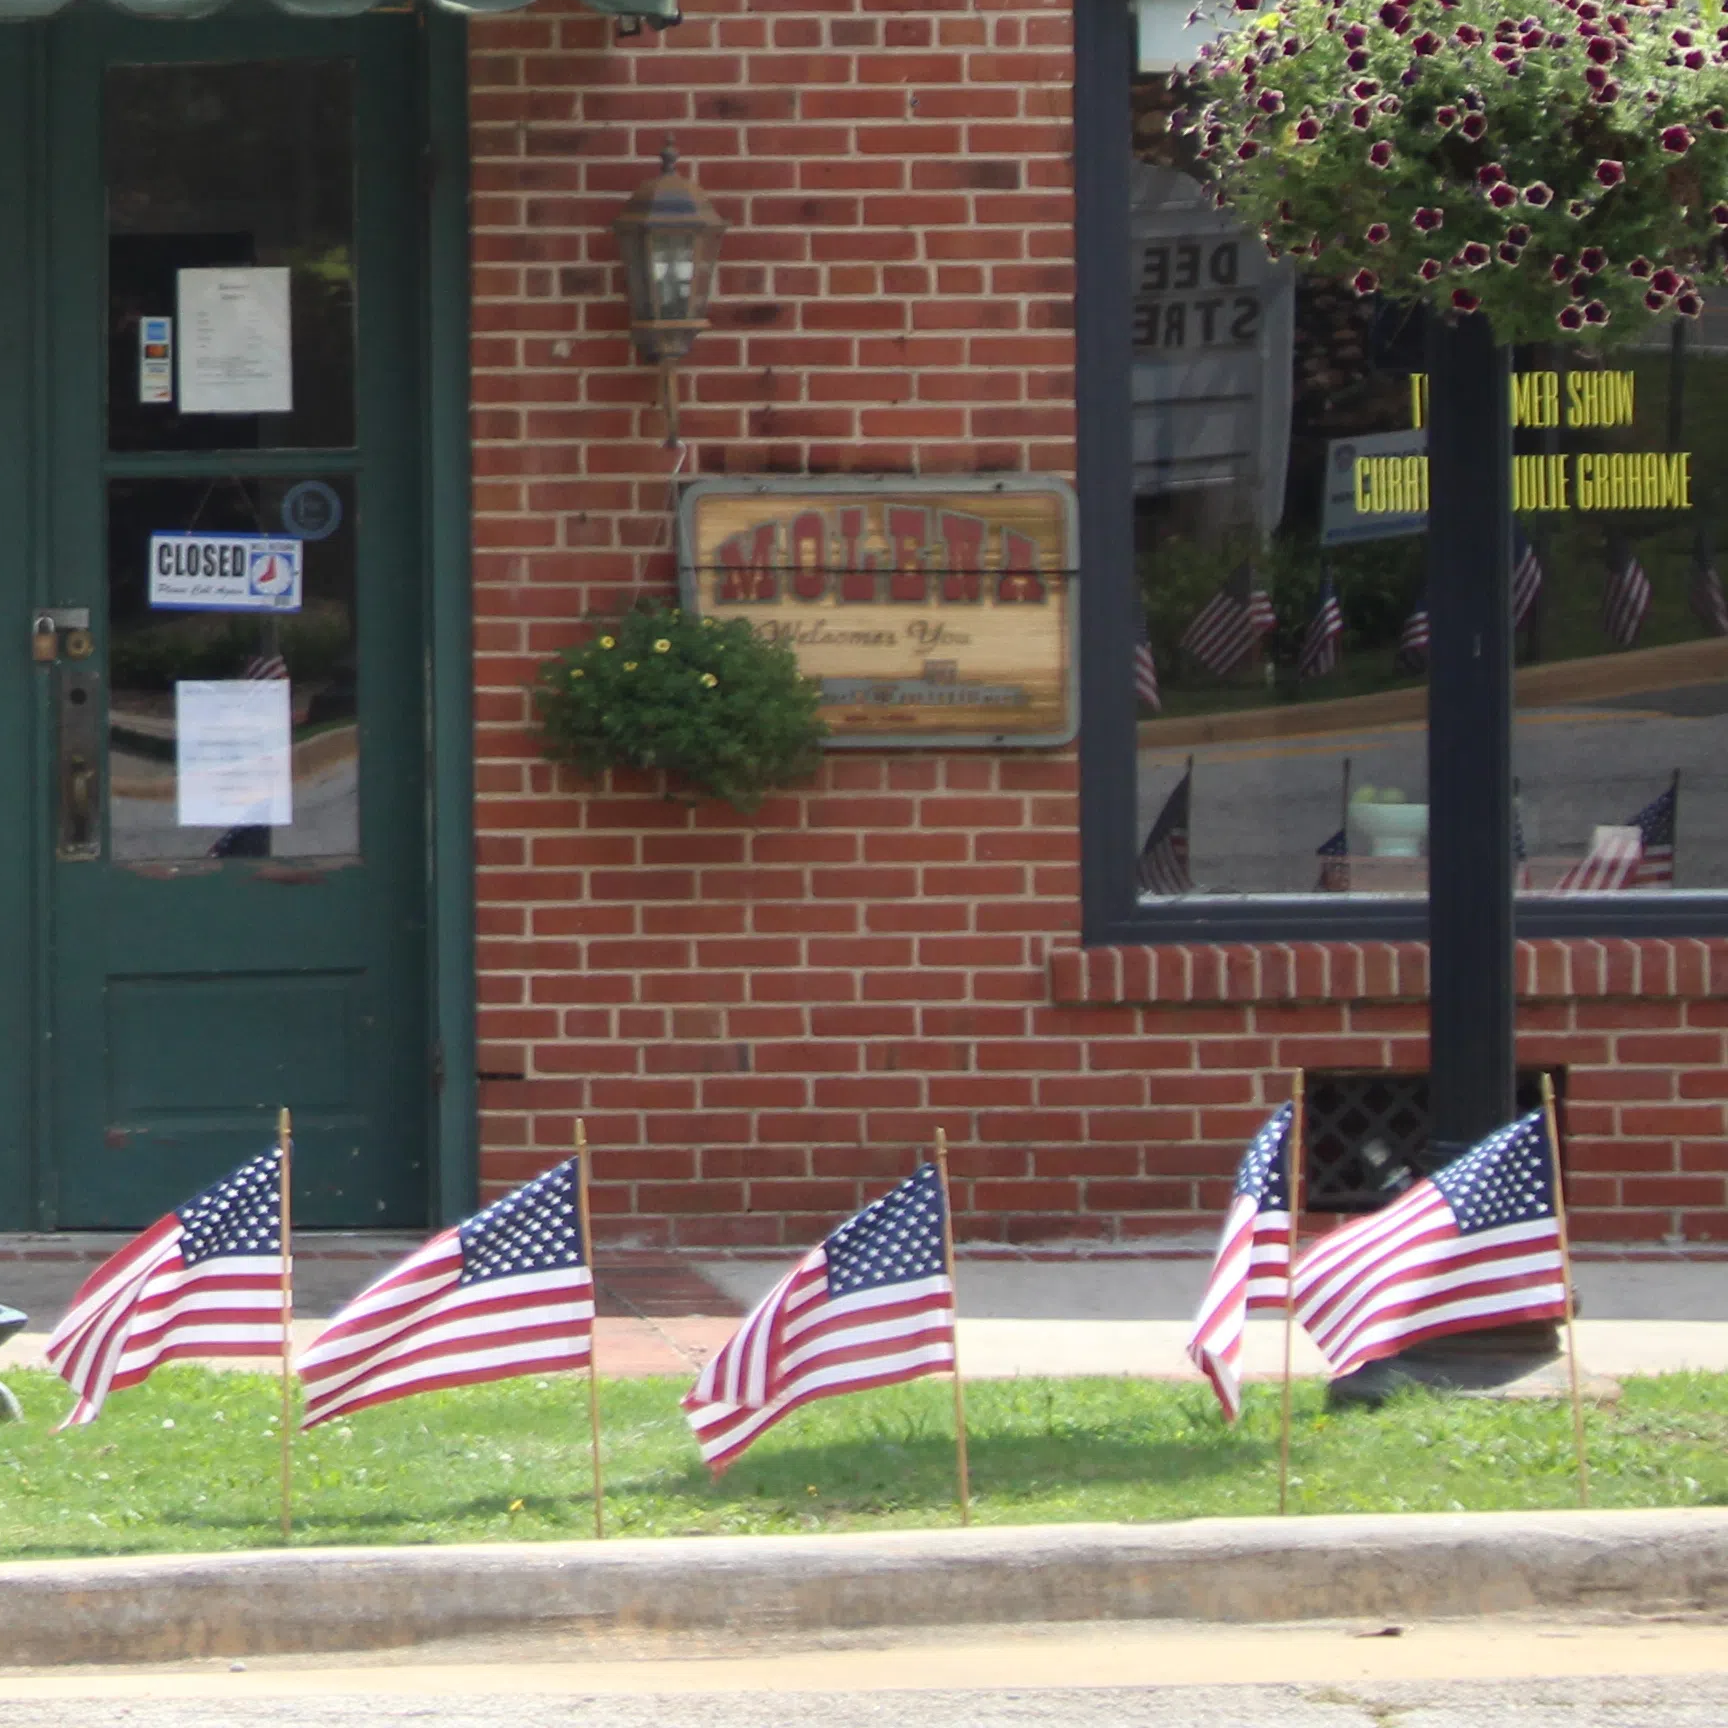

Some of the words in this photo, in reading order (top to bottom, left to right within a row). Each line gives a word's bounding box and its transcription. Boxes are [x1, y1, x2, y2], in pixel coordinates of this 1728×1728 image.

[1566, 370, 1635, 429] SHOW
[1355, 455, 1429, 513] CURAT
[1577, 452, 1694, 512] GRAHAME
[158, 542, 245, 578] CLOSED
[714, 503, 1047, 606] MOLENA
[905, 619, 972, 656] You
